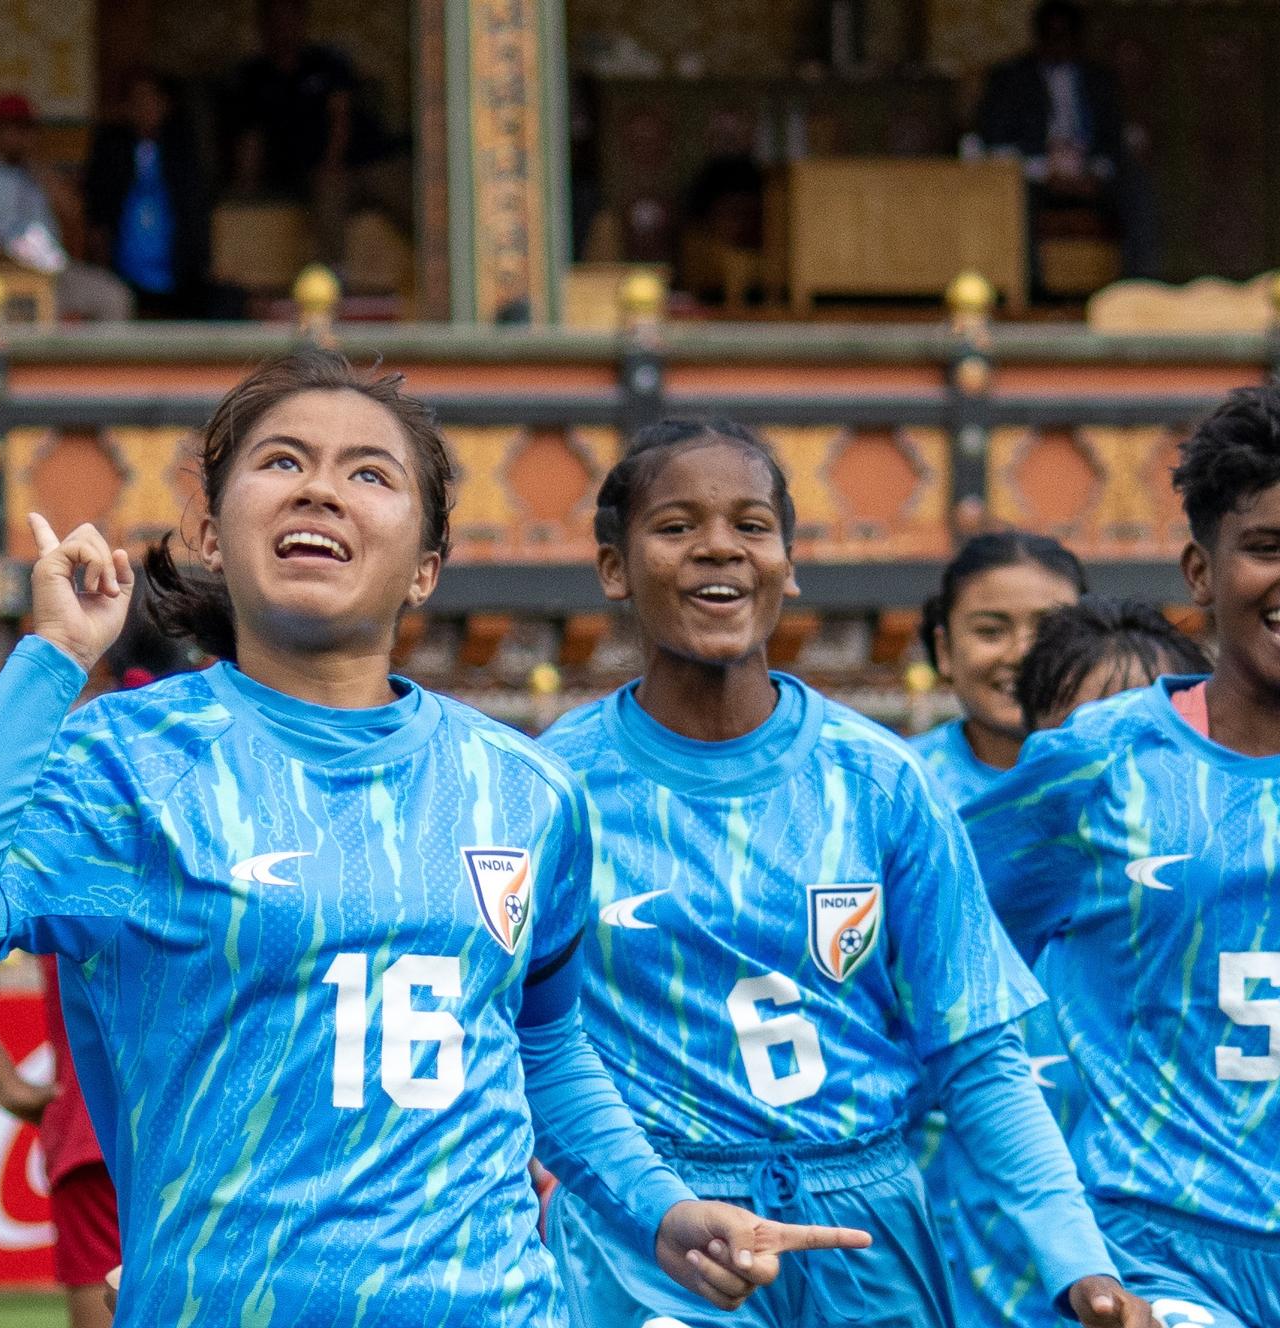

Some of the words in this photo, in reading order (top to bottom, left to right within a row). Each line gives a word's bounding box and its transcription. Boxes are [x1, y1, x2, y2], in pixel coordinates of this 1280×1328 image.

[478, 859, 514, 872] INDIA
[821, 897, 857, 909] INDIA
[322, 953, 464, 1109] 16
[726, 971, 827, 1107] 6
